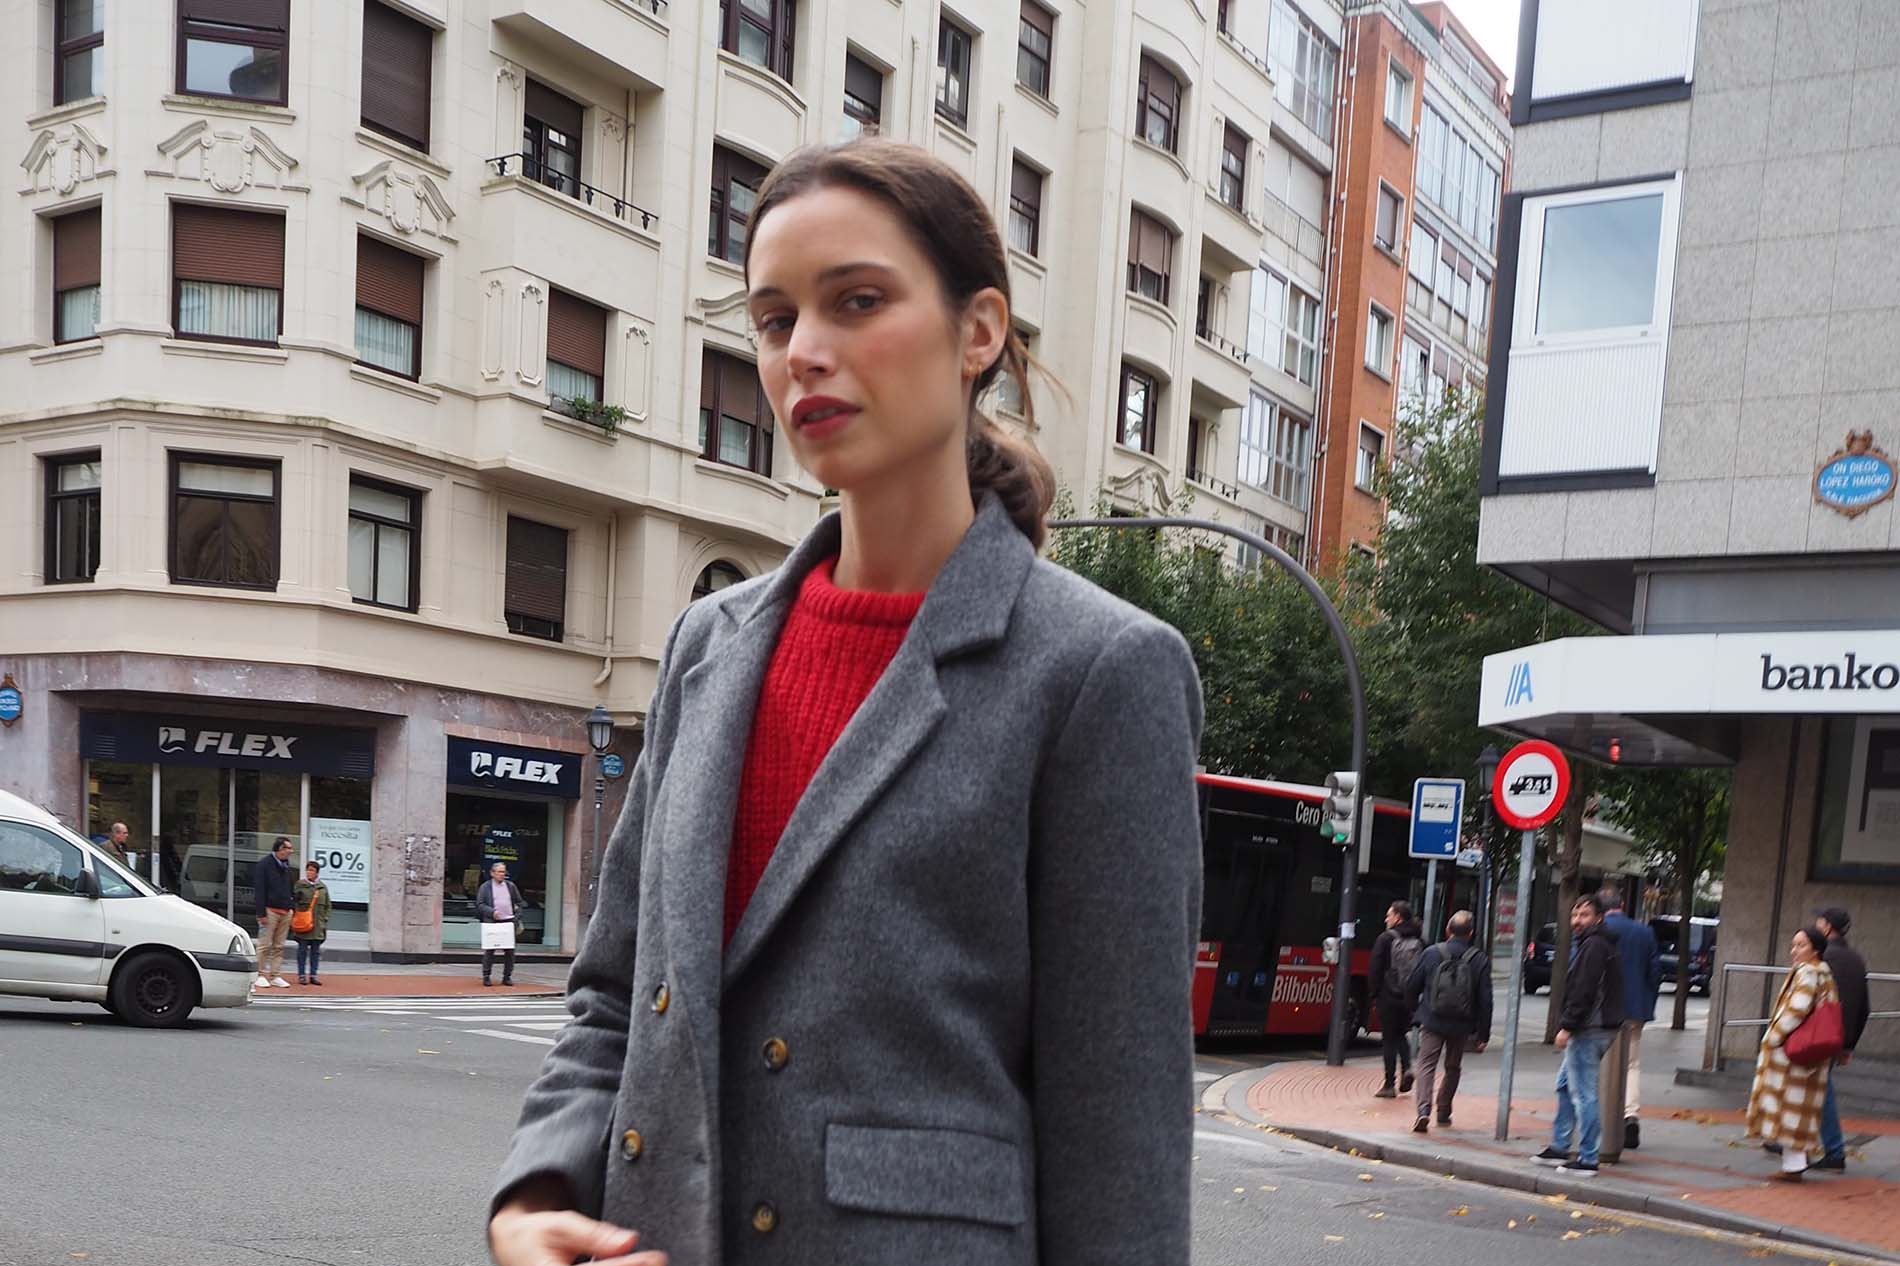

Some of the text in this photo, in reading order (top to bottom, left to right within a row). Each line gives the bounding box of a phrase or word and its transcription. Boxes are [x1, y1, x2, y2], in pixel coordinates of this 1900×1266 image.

[1849, 460, 1879, 474] DIEGO
[194, 730, 299, 759] FLEX
[494, 756, 563, 785] FLEX
[1295, 800, 1321, 826] Cero
[315, 850, 365, 871] 50%
[1271, 975, 1334, 1003] Bilbobus
